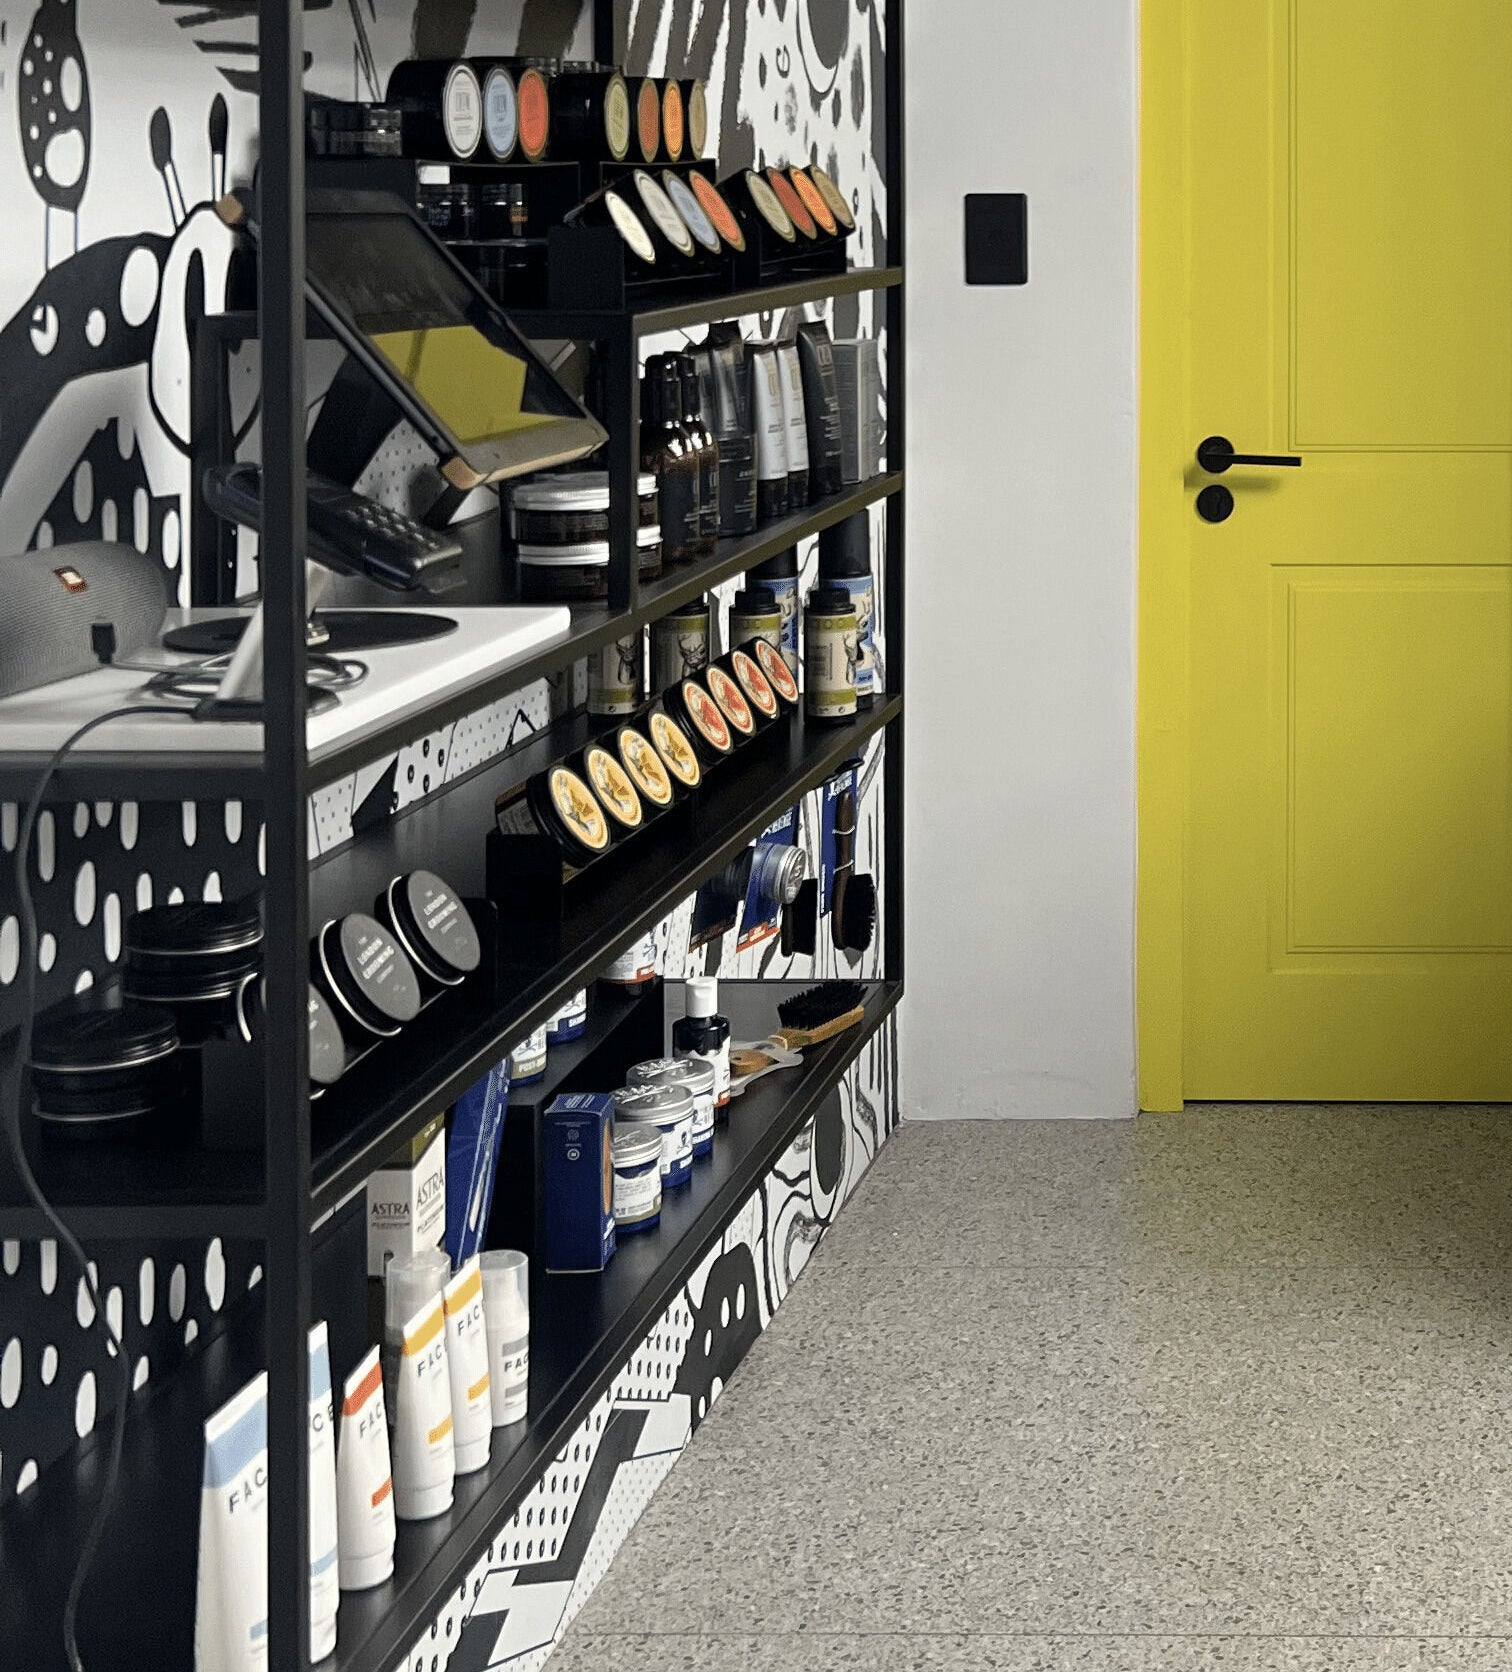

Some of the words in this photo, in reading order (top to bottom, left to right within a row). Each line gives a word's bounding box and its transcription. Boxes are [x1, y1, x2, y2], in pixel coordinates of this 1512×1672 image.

[416, 1167, 444, 1210] ASTRA
[371, 1202, 410, 1215] ASTRA
[457, 1305, 480, 1336] FAC
[417, 1344, 443, 1377] FAC
[504, 1352, 528, 1372] FAC
[360, 1402, 382, 1439] FAC
[229, 1467, 268, 1514] FAC
